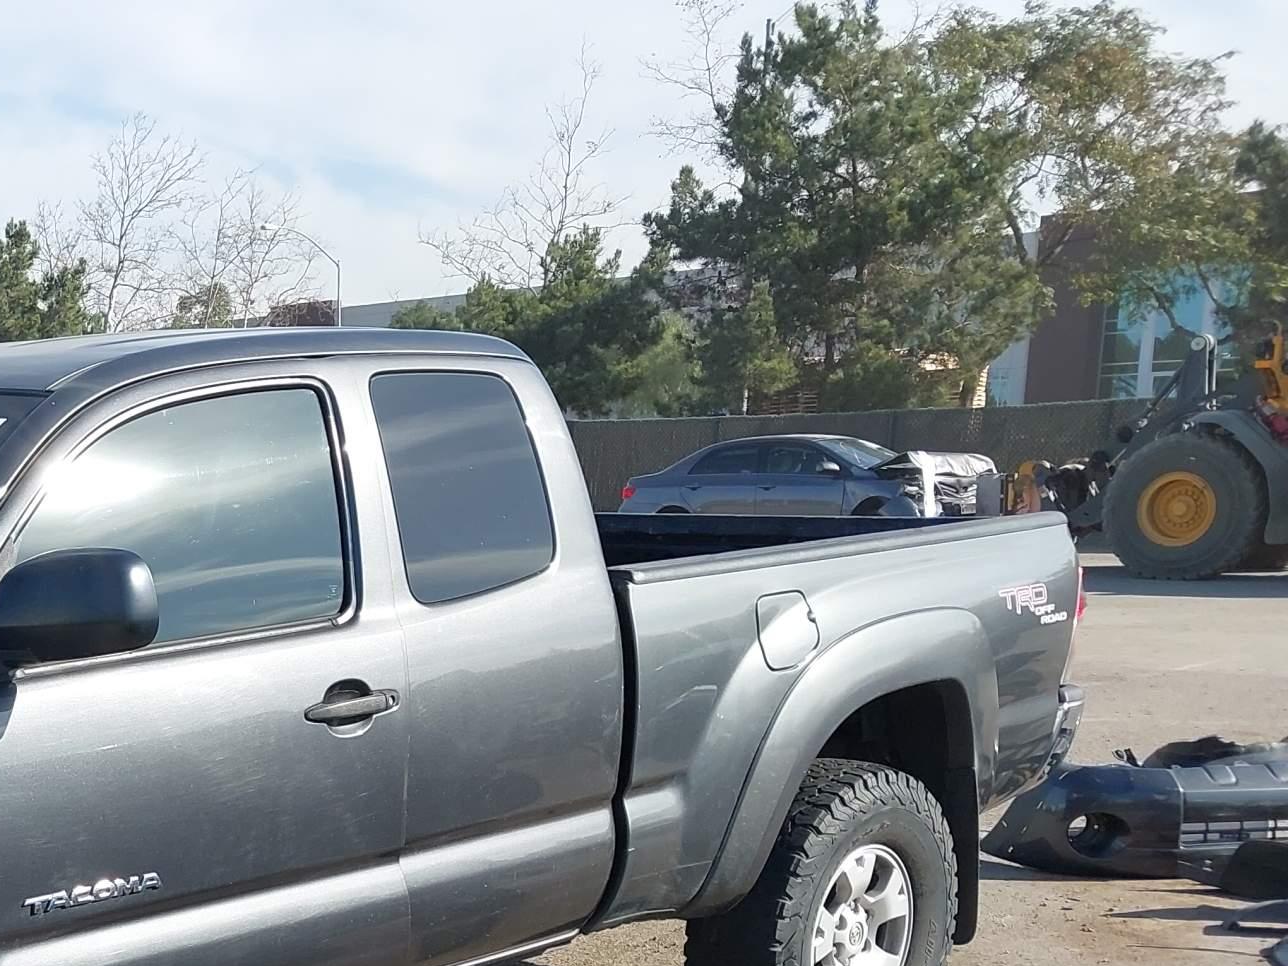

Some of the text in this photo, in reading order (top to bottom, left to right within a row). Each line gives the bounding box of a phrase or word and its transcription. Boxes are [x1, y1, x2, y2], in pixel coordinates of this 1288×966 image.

[998, 583, 1048, 615] TRD
[1034, 603, 1055, 616] OFF
[1040, 611, 1068, 625] ROAD
[21, 871, 164, 917] TACOMA
